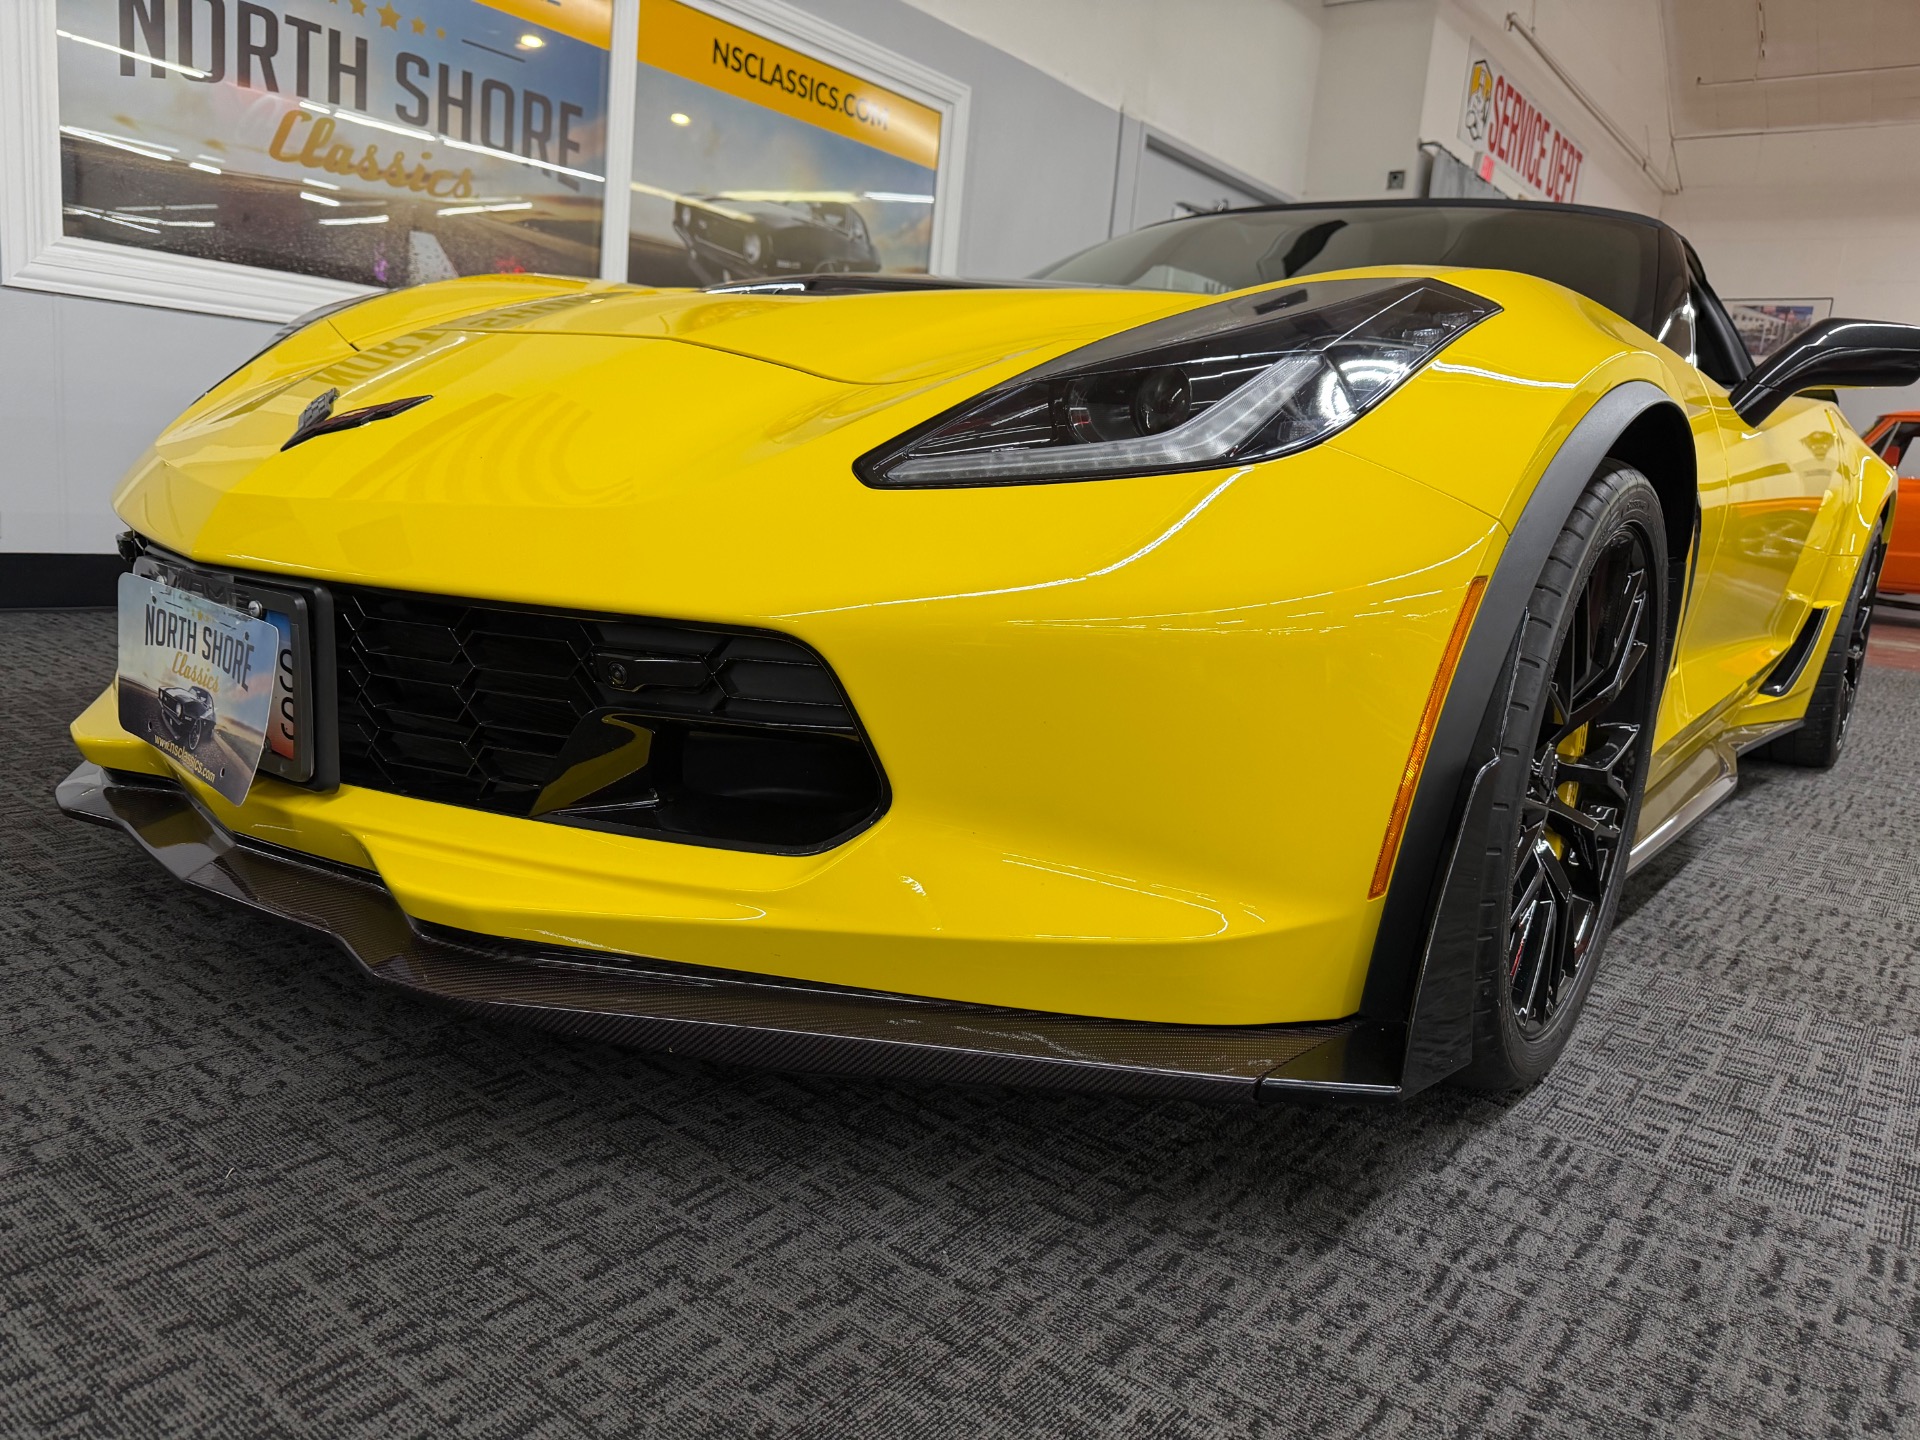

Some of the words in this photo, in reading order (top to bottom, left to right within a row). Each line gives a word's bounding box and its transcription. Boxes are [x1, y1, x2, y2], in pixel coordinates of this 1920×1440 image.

[117, 0, 369, 112] NORTH
[394, 51, 585, 193] SHORE
[712, 38, 890, 131] NSCLASSICS.COM
[268, 109, 476, 200] Classics
[1487, 75, 1551, 189] SERVICE
[1545, 129, 1583, 204] DEPT
[145, 604, 197, 655] NORTH
[201, 626, 255, 692] SHORE
[171, 650, 220, 694] Classics
[154, 734, 216, 784] www.nsclassics.com
